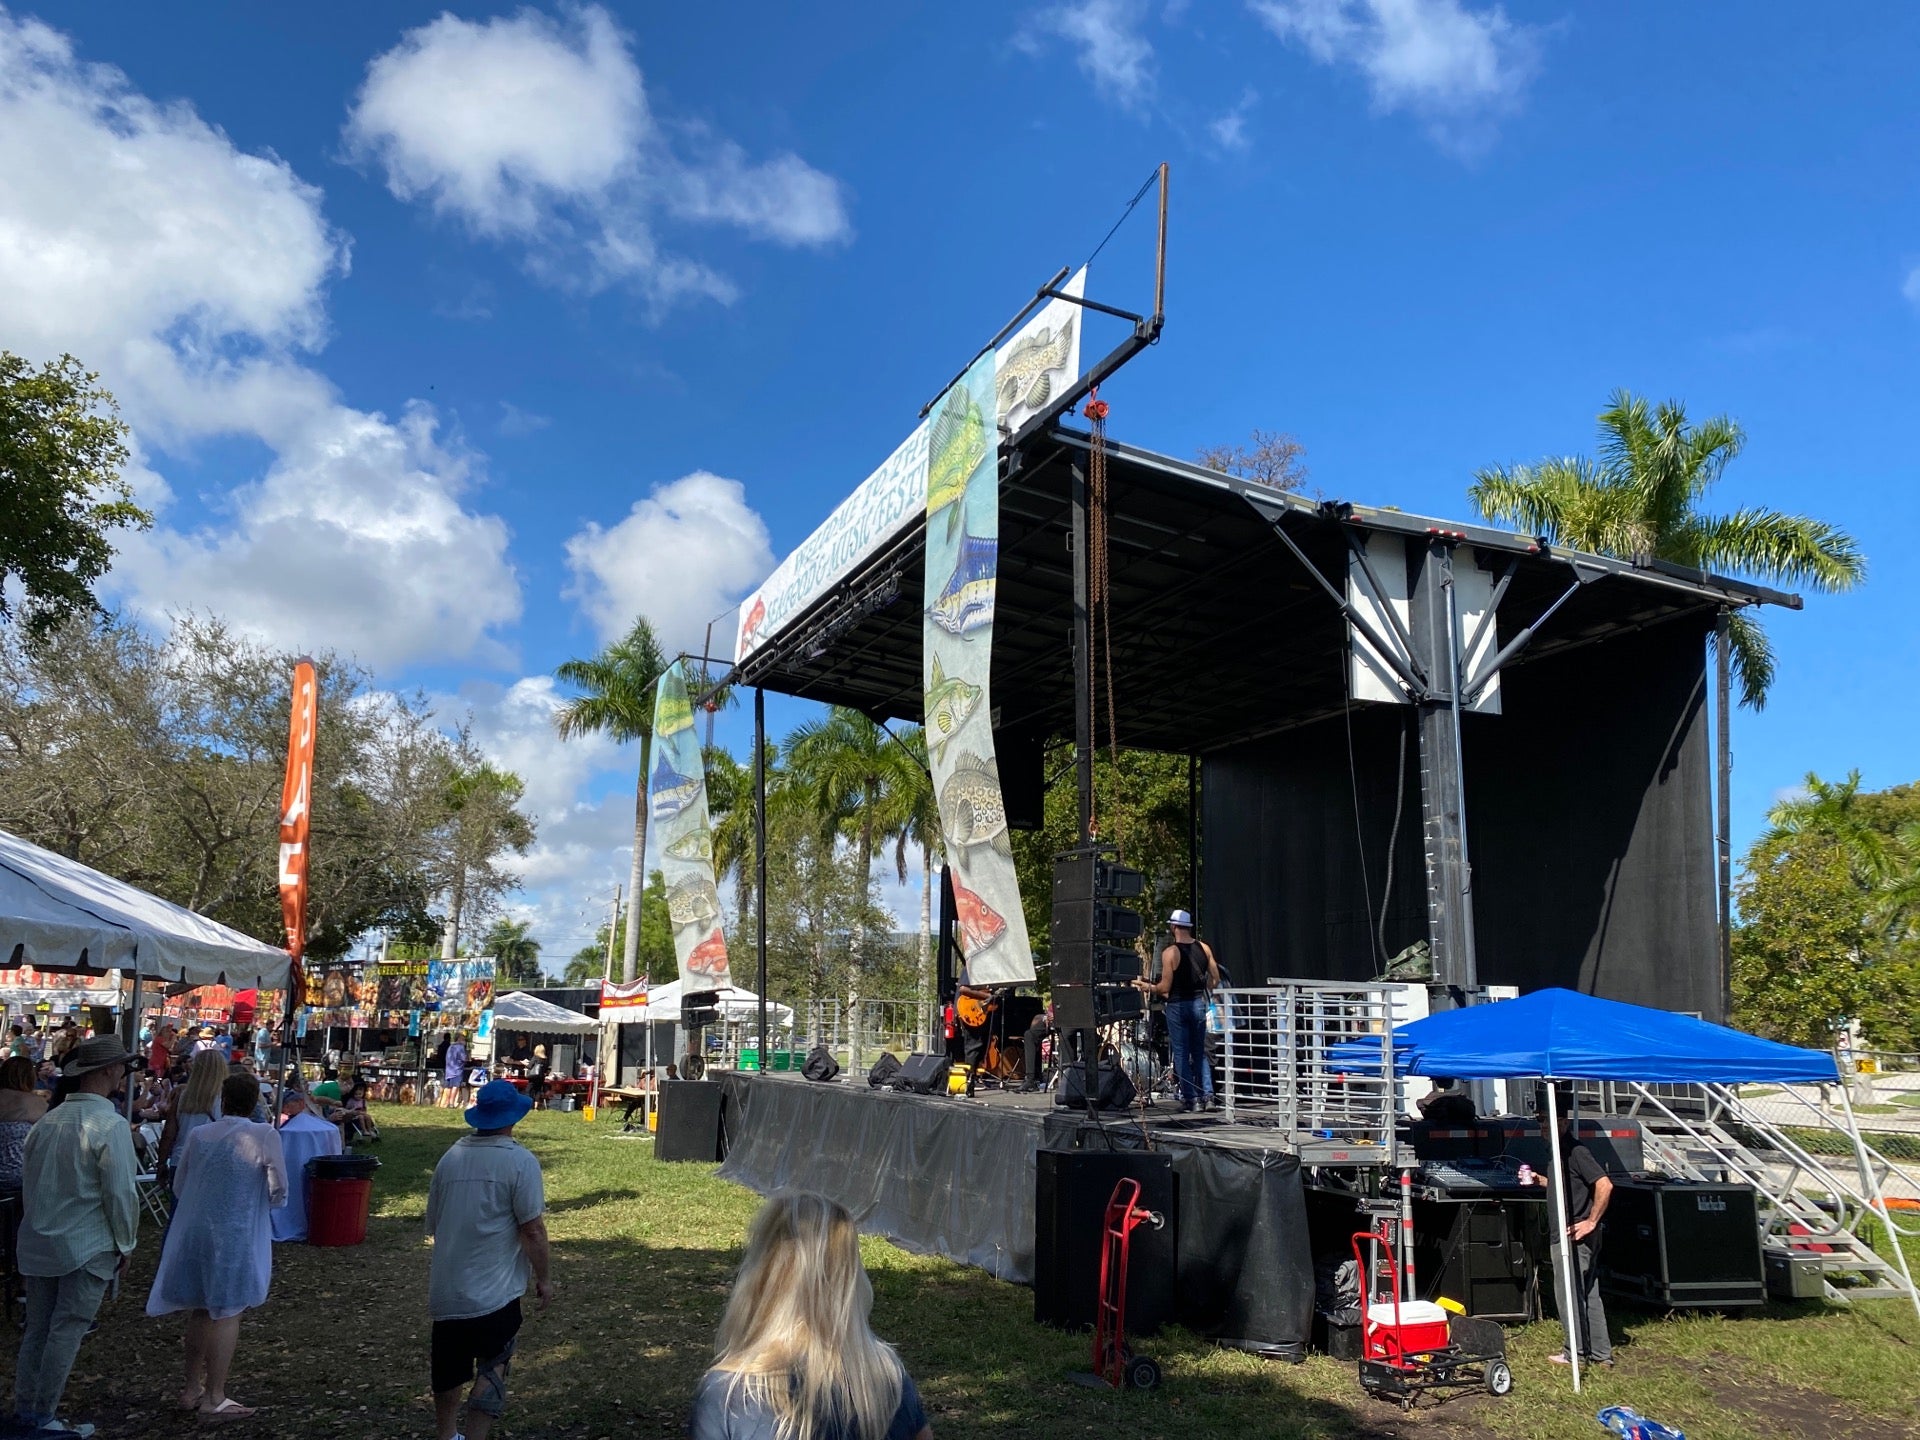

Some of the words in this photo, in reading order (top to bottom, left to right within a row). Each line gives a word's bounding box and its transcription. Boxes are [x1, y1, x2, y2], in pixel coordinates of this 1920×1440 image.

[763, 562, 816, 634] SEAFOOD
[816, 552, 829, 586] &
[828, 505, 873, 577] MUSIC
[795, 494, 860, 575] WELCOME
[861, 466, 888, 510] TO
[889, 424, 929, 482] THE
